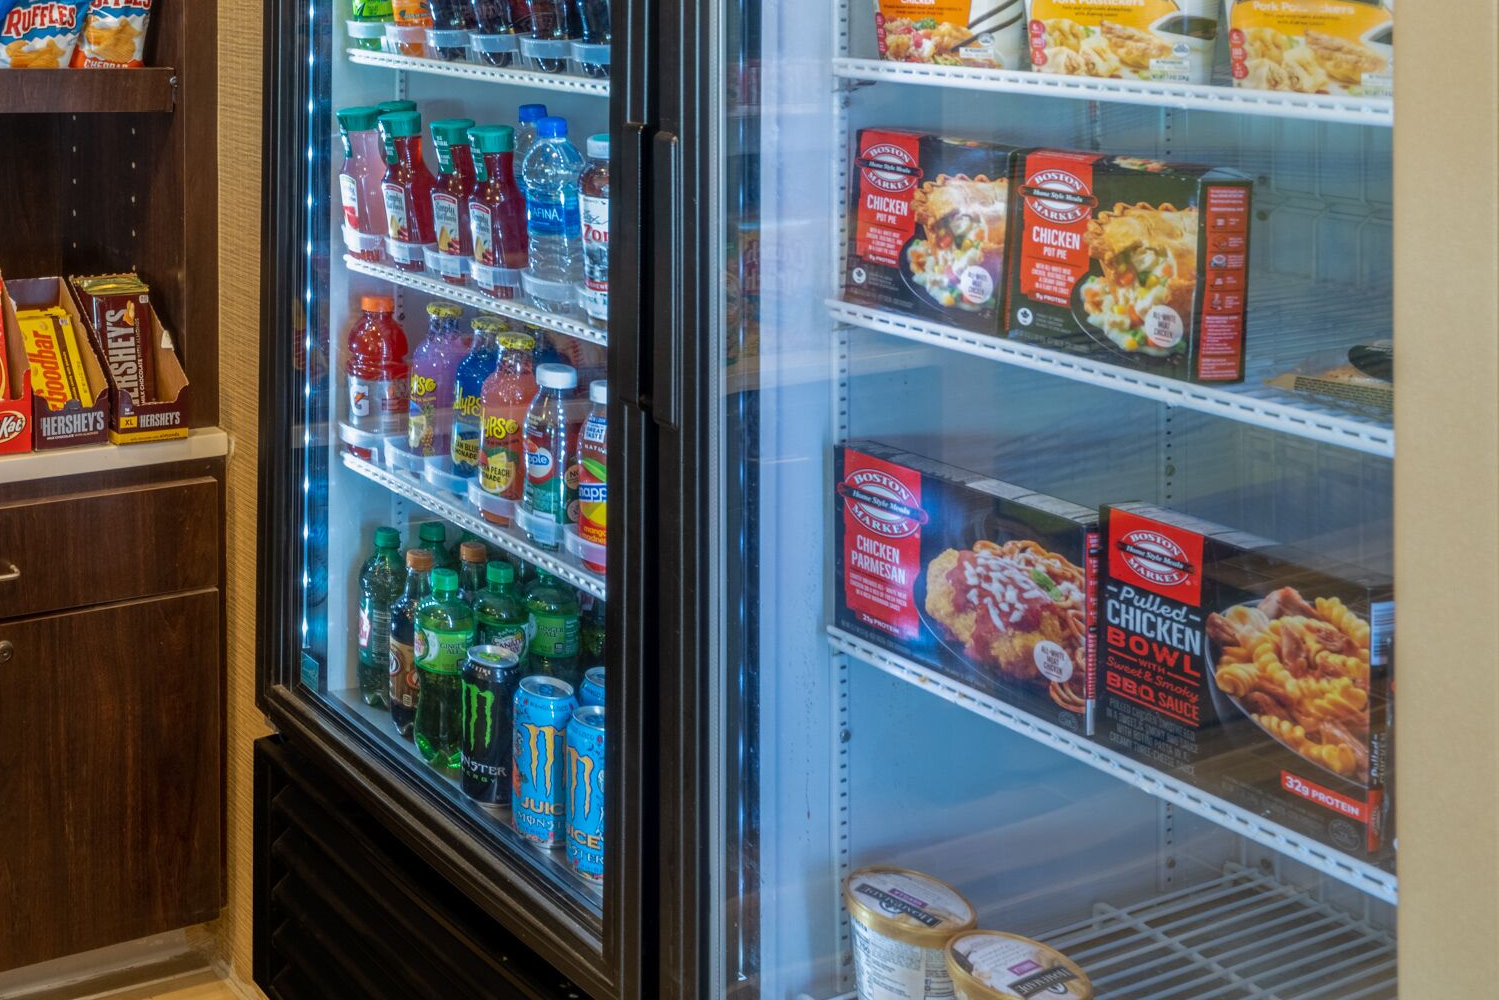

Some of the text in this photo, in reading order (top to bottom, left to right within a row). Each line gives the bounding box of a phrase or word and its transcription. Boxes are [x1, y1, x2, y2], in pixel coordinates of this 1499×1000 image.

[4, 4, 76, 37] RUFFLES
[869, 145, 911, 164] BOSTON
[867, 161, 913, 175] Home Style Meals
[866, 173, 910, 193] MARKET
[1034, 171, 1083, 191] BOSTON
[866, 195, 909, 217] CHICKEN
[1033, 189, 1083, 205] Home Style Meals
[876, 214, 897, 225] POT PIE
[1032, 203, 1083, 224] MARKET
[1031, 227, 1081, 251] CHICKEN
[1042, 247, 1068, 260] POT PIE
[1044, 294, 1068, 304] PROTEIN
[41, 411, 104, 437] HERSHEY'S
[124, 418, 134, 426] XL
[139, 412, 180, 428] HERSHEY'S
[490, 466, 510, 478] PEACH
[853, 471, 910, 501] BOSTON
[852, 503, 909, 534] MARKET
[856, 534, 900, 564] CHICKEN
[1129, 531, 1181, 556] BOSTON
[851, 552, 906, 585] PARMESAN
[1125, 545, 1184, 570] Home Style Meals
[1128, 558, 1181, 584] MARKET
[1119, 586, 1188, 623] Pulled
[537, 624, 565, 634] GINGER
[1106, 600, 1200, 656] CHICKEN
[1106, 626, 1200, 678] BOWL
[1106, 655, 1200, 702] Sweet & Smoky
[1106, 670, 1200, 721] BBQ SAUCE
[1285, 775, 1360, 818] 32g PROTEIN
